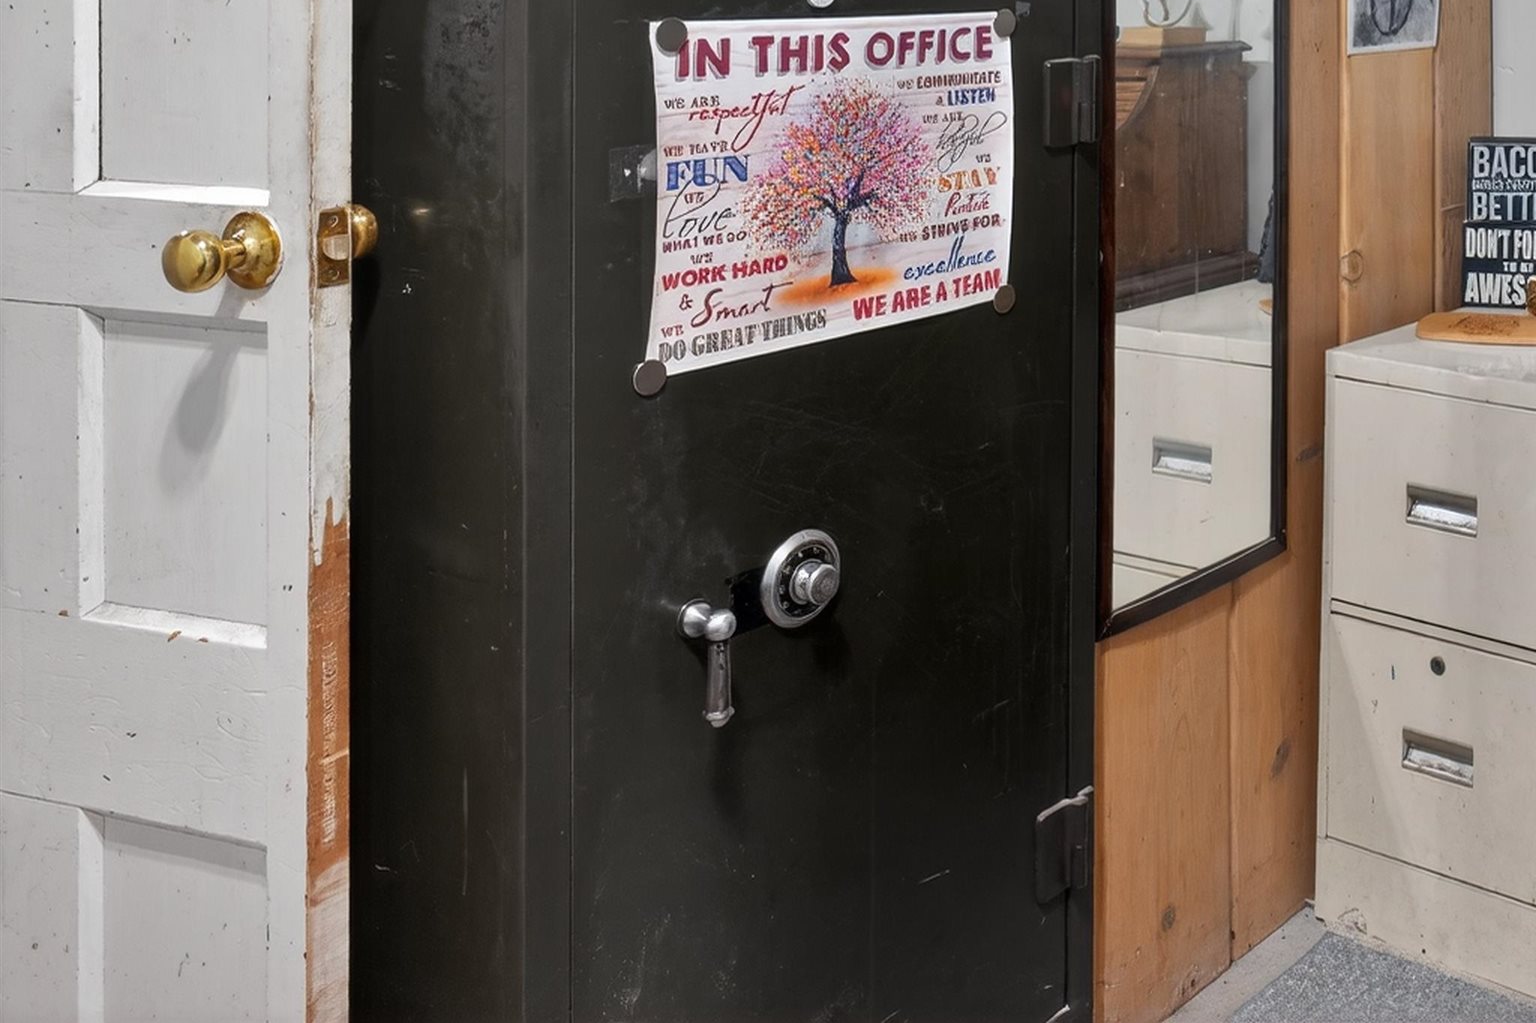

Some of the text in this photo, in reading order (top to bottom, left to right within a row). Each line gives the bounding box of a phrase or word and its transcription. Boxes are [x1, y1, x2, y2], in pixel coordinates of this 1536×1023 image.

[675, 26, 993, 82] IN THIS OFFICE
[946, 87, 995, 107] LISTEN
[666, 154, 751, 192] FUN
[662, 238, 699, 254] WHAT
[703, 232, 724, 246] WE
[921, 218, 969, 241] STRIVE
[972, 213, 1001, 231] FOR
[1464, 227, 1512, 260] DON'T
[662, 254, 789, 292] WORK HARD
[903, 234, 997, 281] excellence
[1502, 260, 1517, 273] TO
[679, 281, 794, 329] & Smart
[853, 267, 1003, 322] WE ARE A TEAM
[657, 308, 828, 363] DO GREAT THINGS
[660, 324, 684, 339] WE
